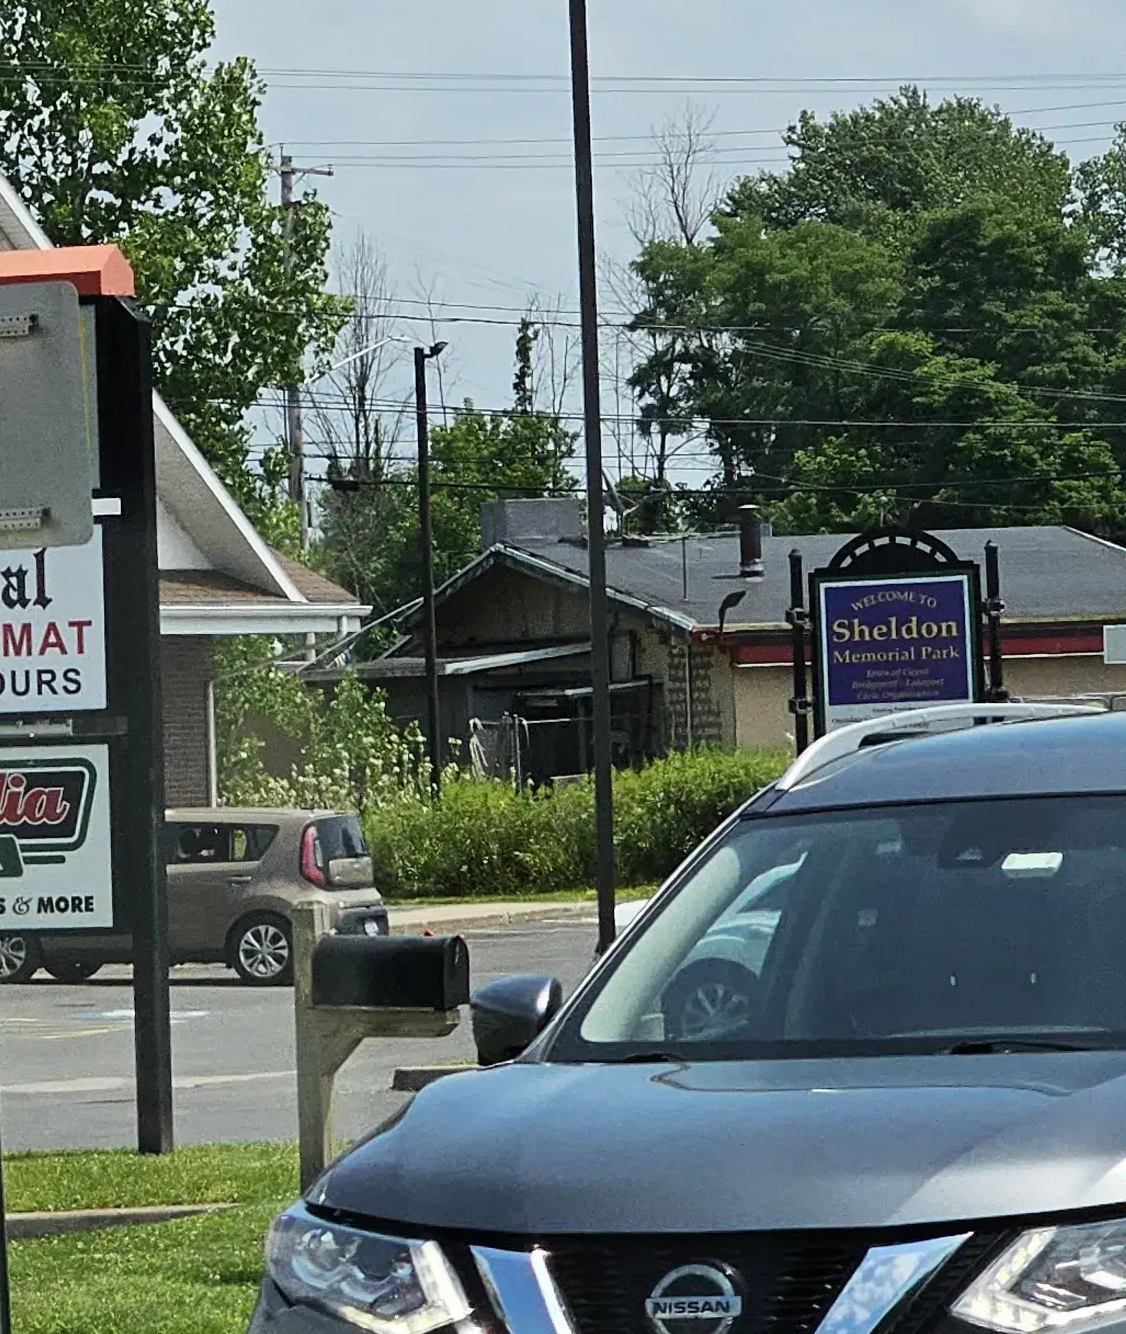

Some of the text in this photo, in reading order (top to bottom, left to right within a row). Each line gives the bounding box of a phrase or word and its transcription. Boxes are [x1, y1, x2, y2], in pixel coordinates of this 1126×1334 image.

[850, 590, 938, 611] WELCOME TO
[832, 616, 959, 643] Sheldon
[833, 645, 961, 664] Memorial Park
[12, 896, 33, 915] &
[37, 895, 94, 915] MORE
[653, 1300, 730, 1315] NISSAN
